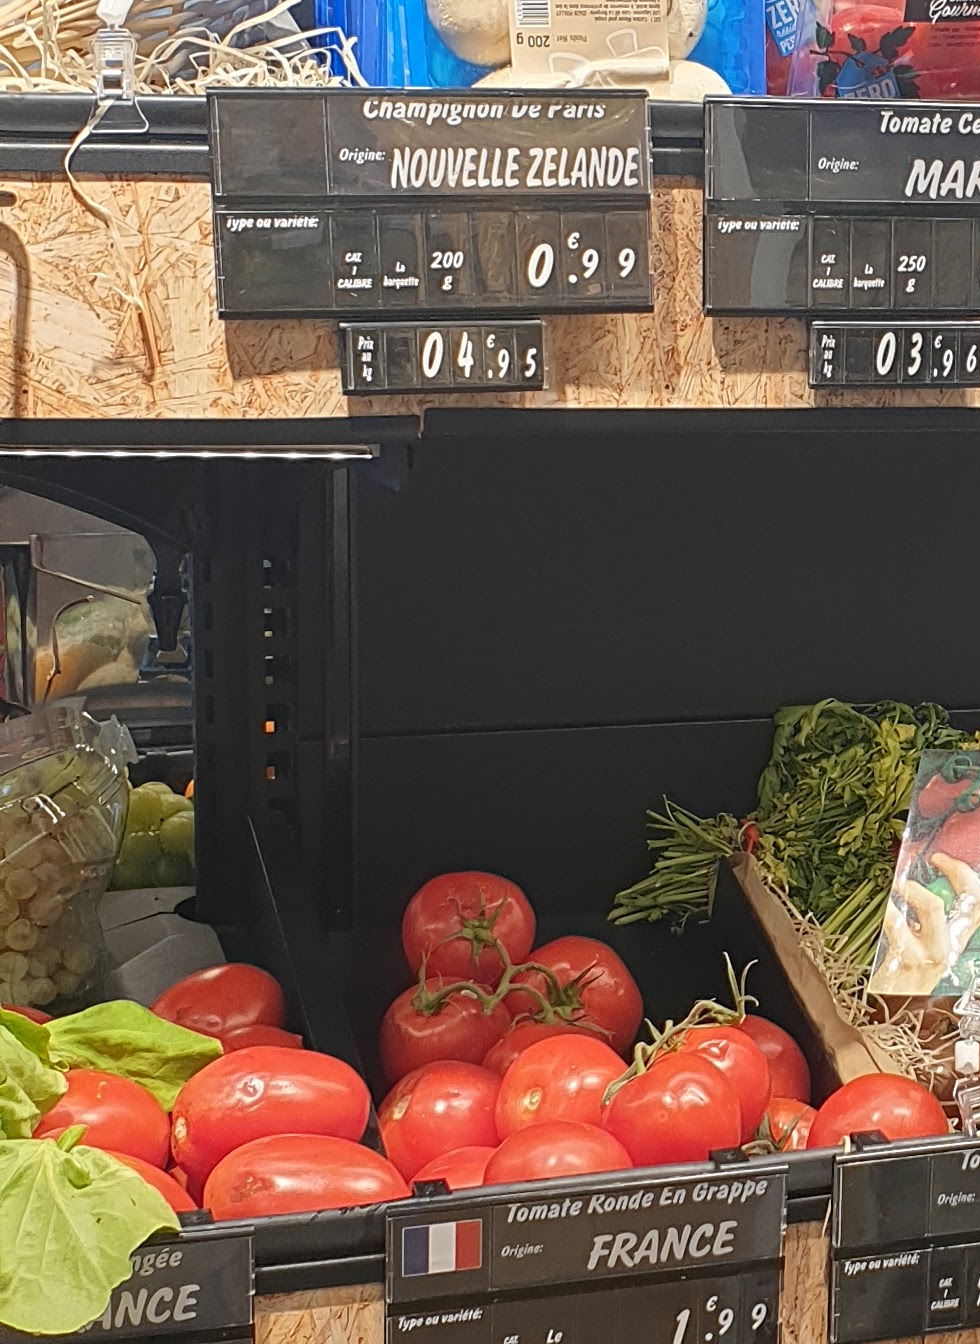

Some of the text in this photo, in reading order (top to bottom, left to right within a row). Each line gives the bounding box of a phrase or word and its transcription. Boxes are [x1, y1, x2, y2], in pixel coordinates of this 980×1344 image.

[517, 33, 550, 47] 200 g
[362, 100, 503, 125] Champignon
[880, 111, 952, 135] Tomate
[339, 146, 639, 189] Origine: NOUVELLE ZELANDE
[818, 158, 859, 173] Origine:
[744, 220, 757, 230] ou
[431, 252, 463, 292] 200 g
[898, 255, 926, 292] 250 g
[506, 1180, 768, 1224] Tomate Ronde En Grappe
[937, 1192, 975, 1206] Origine:
[501, 1220, 738, 1270] Origine: FRANCE
[546, 1329, 562, 1344] Le
